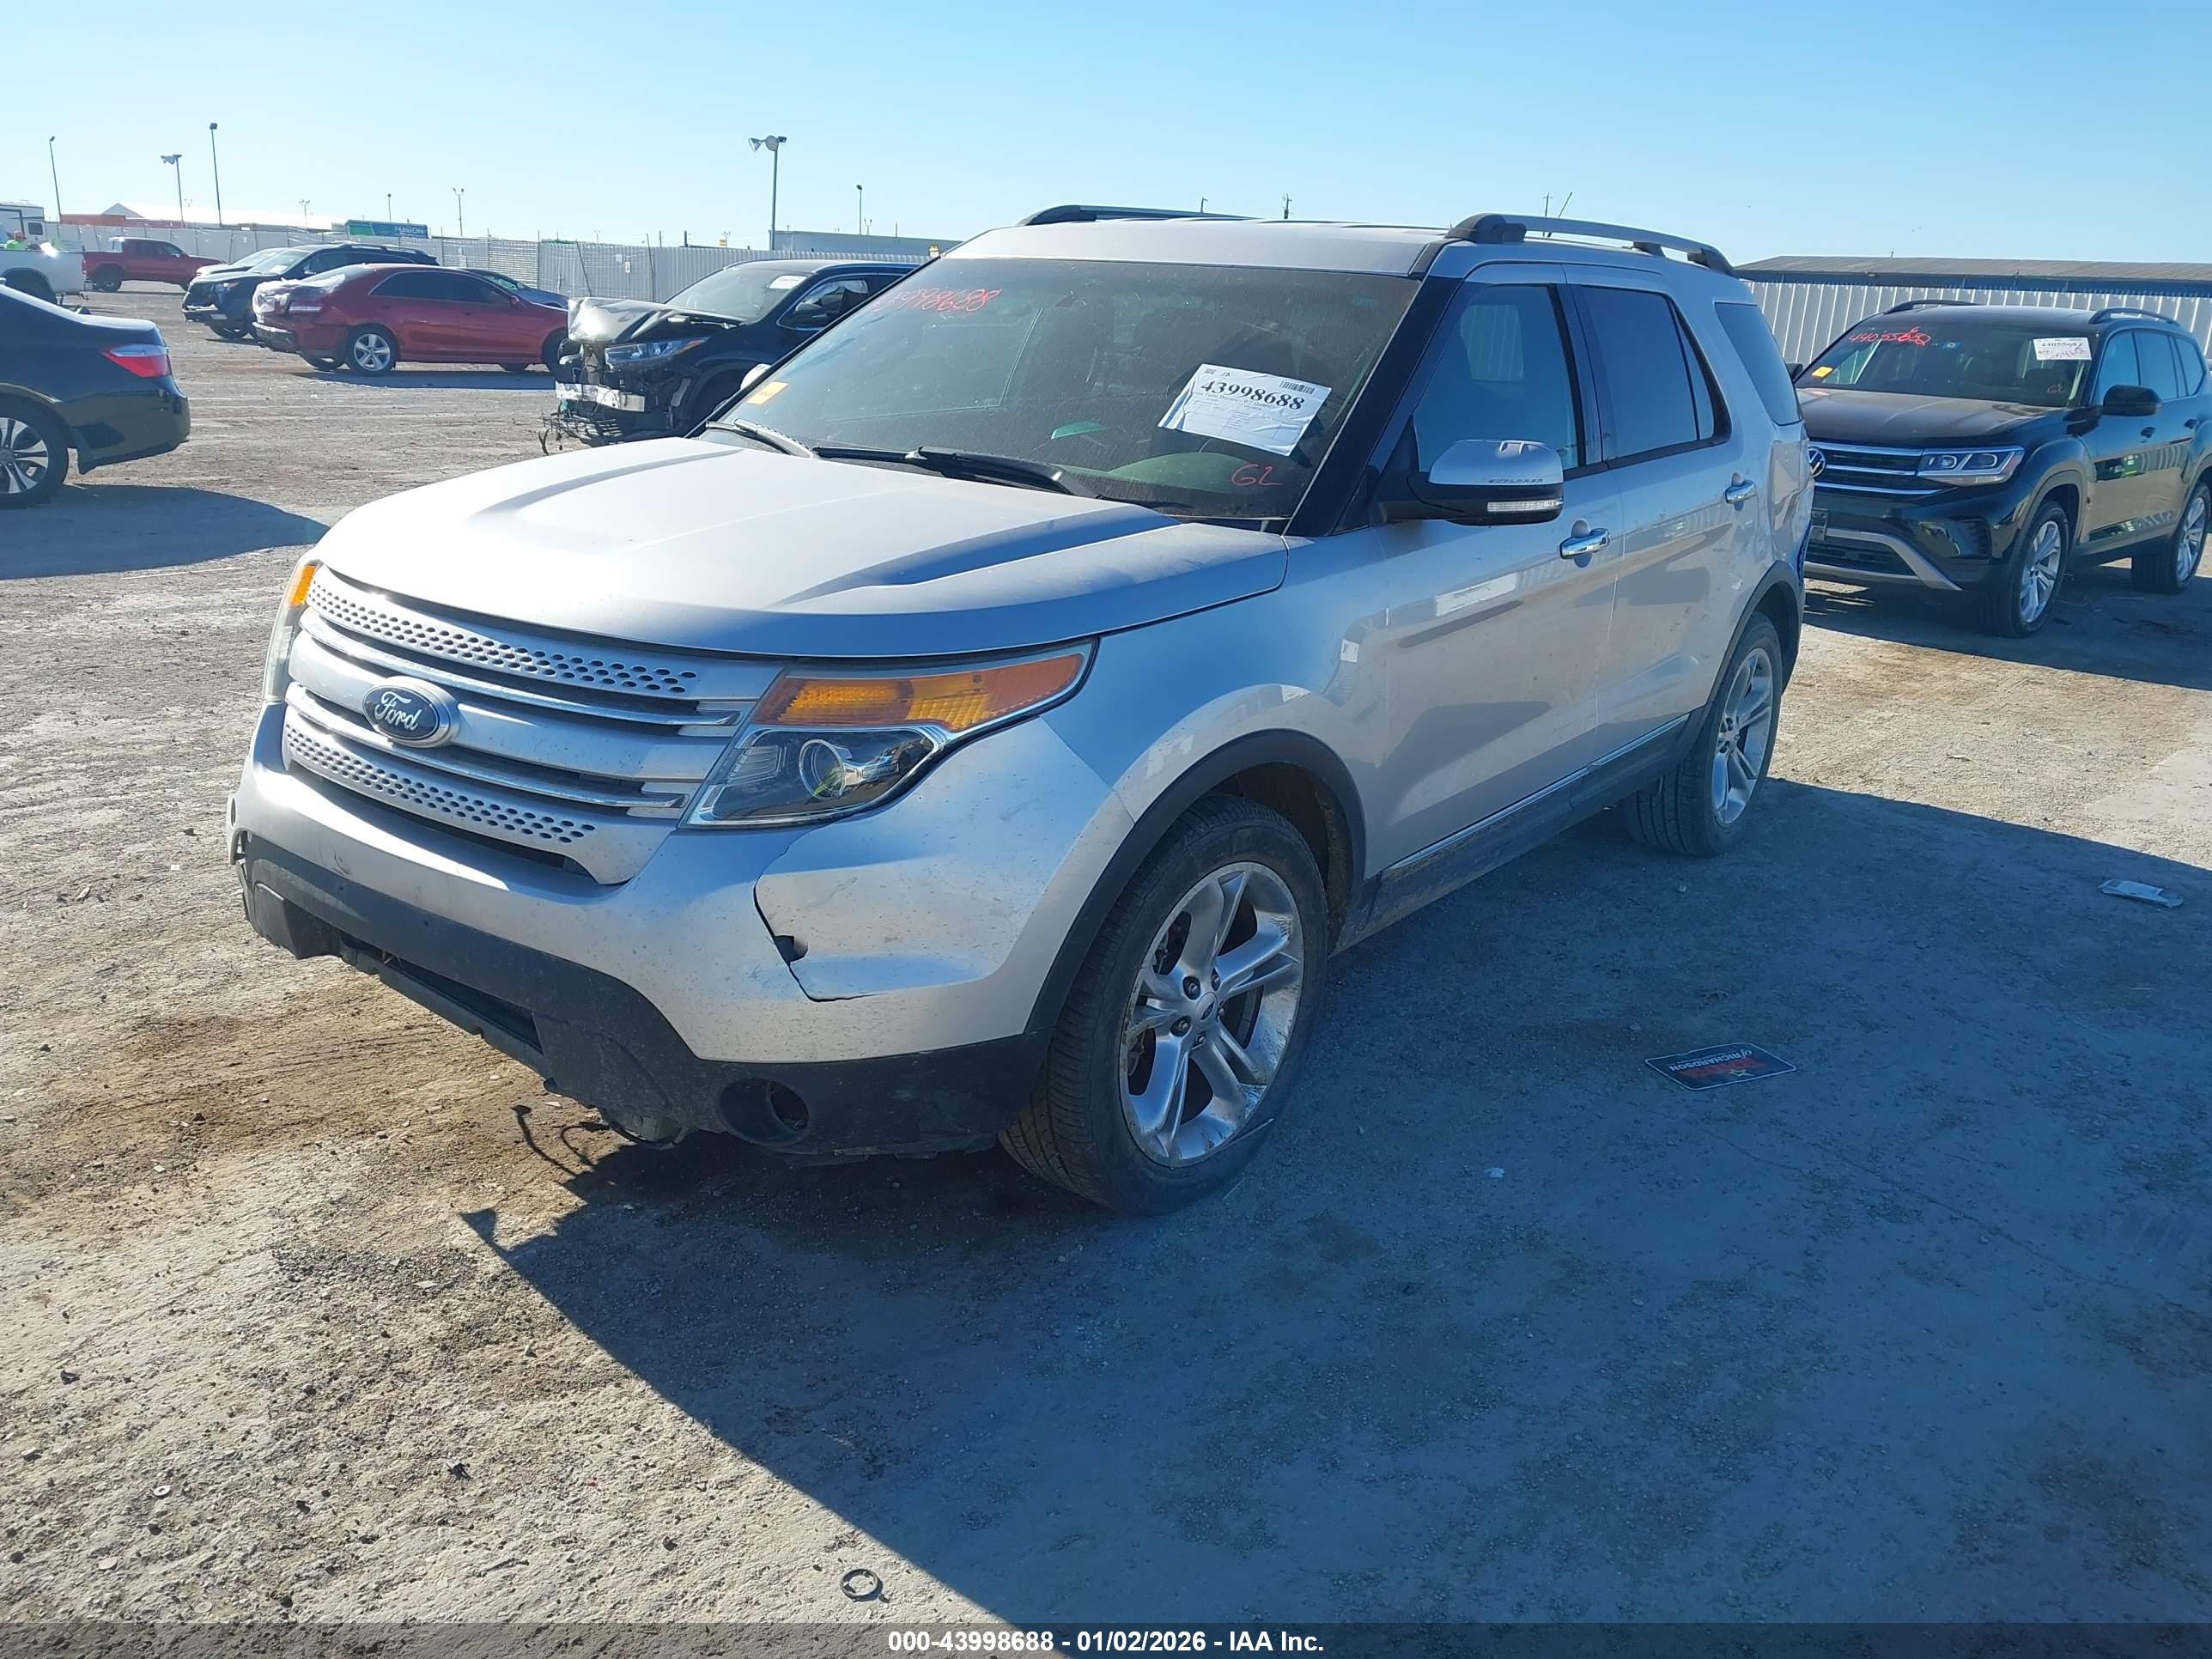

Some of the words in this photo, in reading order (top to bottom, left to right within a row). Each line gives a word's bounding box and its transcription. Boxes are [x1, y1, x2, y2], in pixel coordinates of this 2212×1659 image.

[1200, 380, 1305, 410] 43998688
[374, 690, 422, 731] Ford
[1668, 1051, 1740, 1072] RICHARDSON
